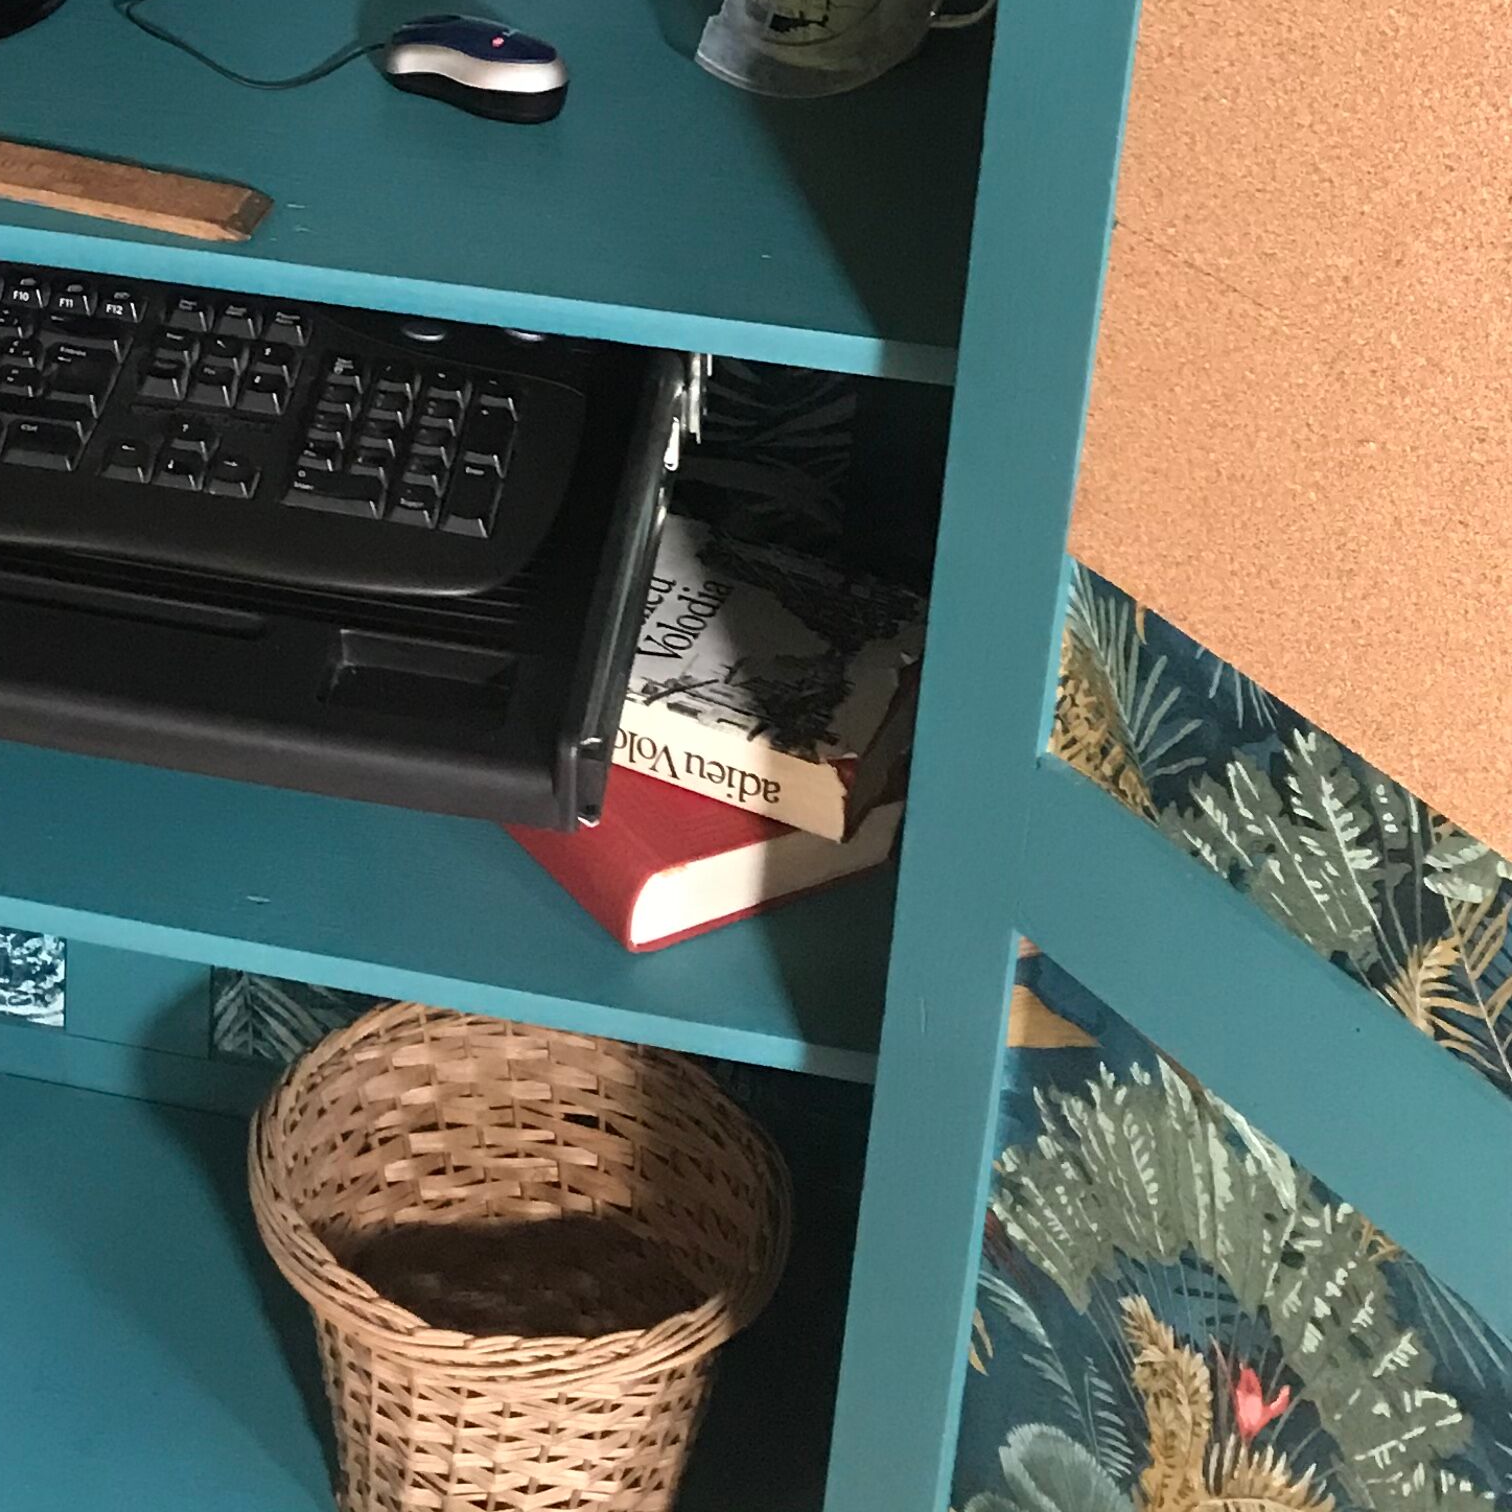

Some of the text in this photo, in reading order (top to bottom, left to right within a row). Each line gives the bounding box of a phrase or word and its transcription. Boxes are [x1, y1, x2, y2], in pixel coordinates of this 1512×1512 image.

[13, 290, 30, 302] F10
[59, 297, 74, 308] F11
[106, 304, 124, 315] F12
[636, 580, 734, 659] Volodia
[684, 751, 782, 804] adieu
